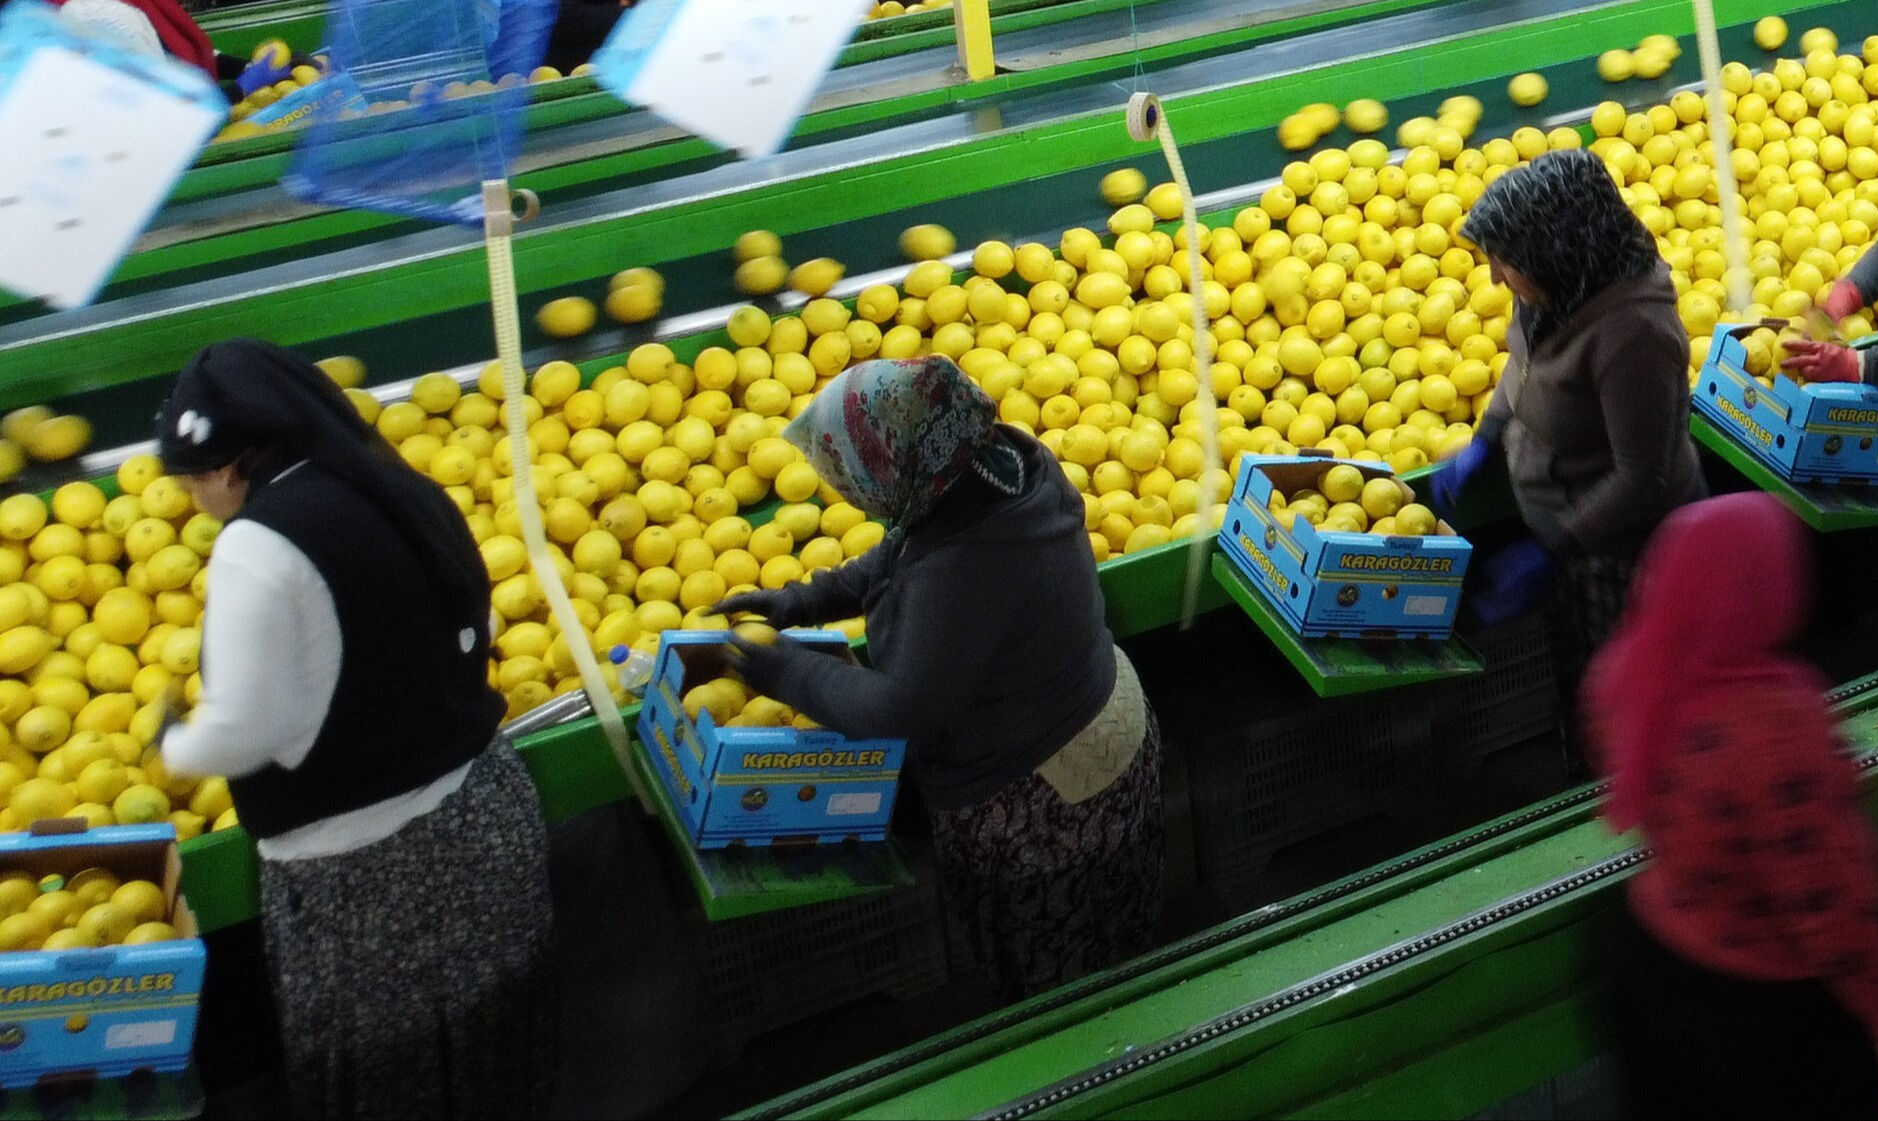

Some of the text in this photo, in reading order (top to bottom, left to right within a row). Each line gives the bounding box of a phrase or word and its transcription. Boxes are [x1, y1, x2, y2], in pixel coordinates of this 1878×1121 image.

[1717, 394, 1772, 445] KARAGÖZLER
[1340, 554, 1452, 572] KARAGÖZLER
[742, 748, 885, 769] KARAGÖZLER
